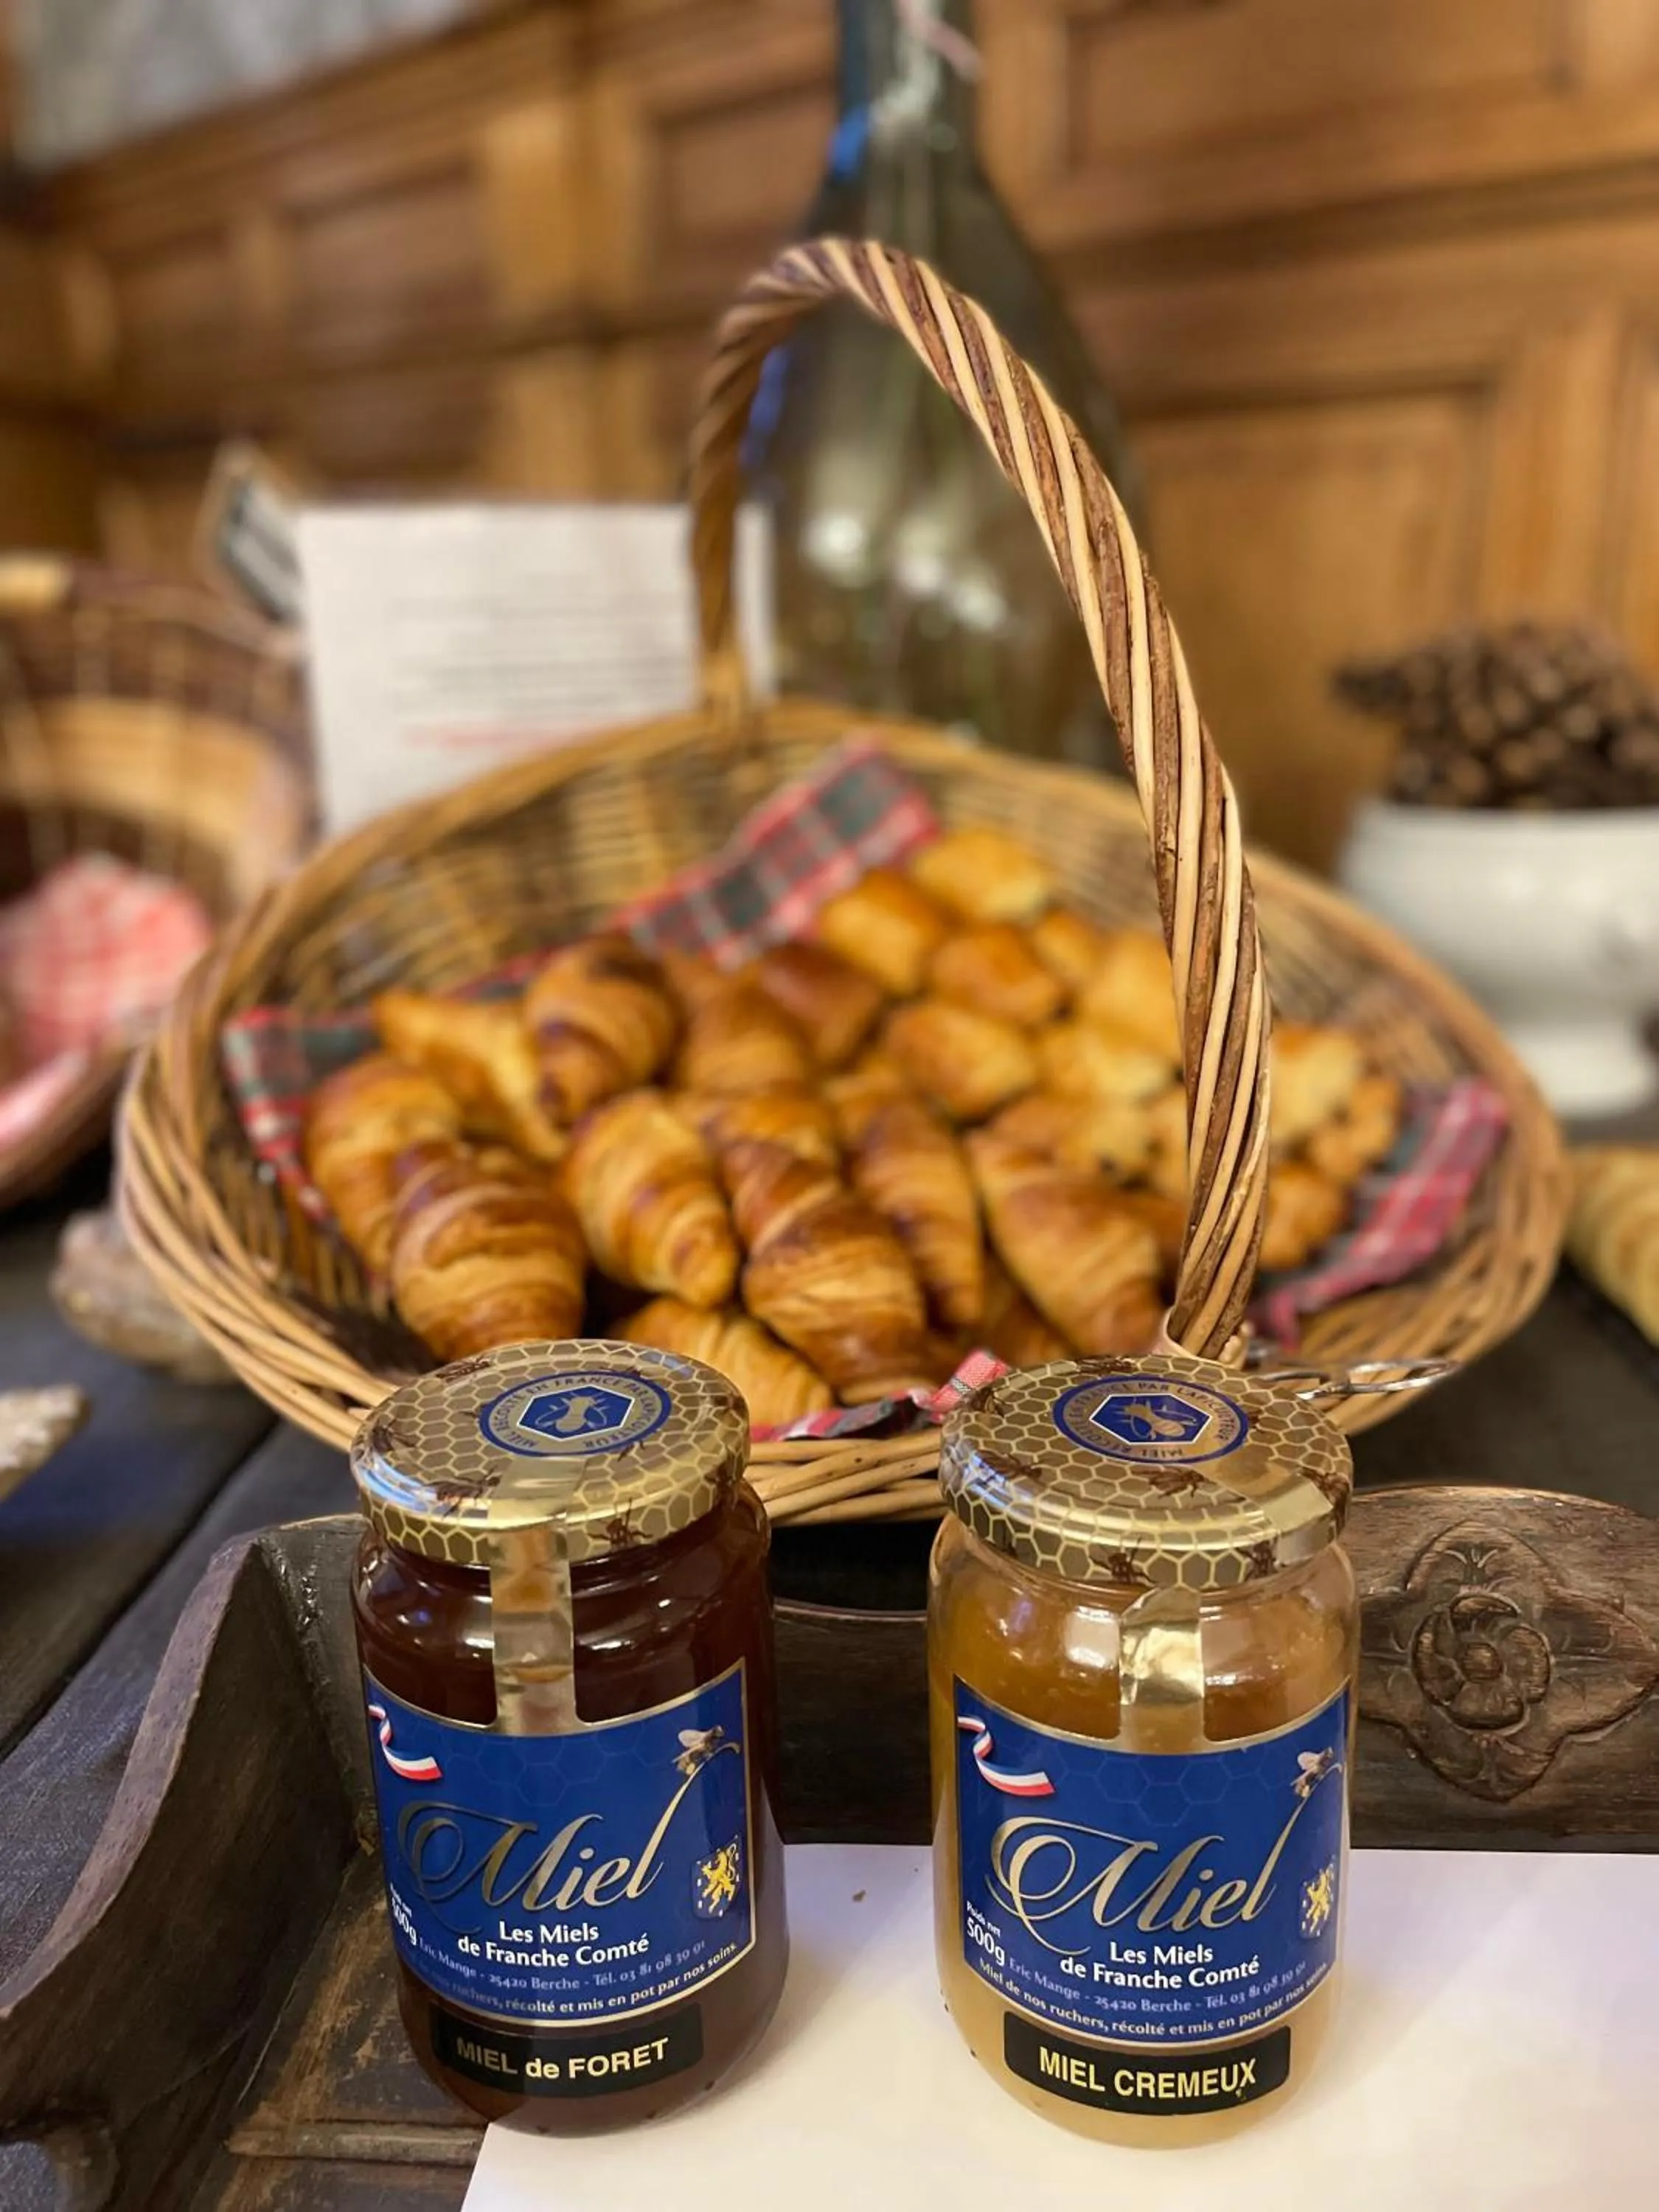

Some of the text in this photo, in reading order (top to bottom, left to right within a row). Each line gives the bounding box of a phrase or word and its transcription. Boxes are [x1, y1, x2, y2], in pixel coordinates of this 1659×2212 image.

[554, 1376, 622, 1386] FRANCE
[1137, 1382, 1169, 1391] PAR
[398, 1742, 740, 1933] Miel
[984, 1763, 1342, 1955] Miel
[457, 1932, 650, 1967] de Franche Comté
[499, 1921, 599, 1944] Les Miels
[966, 1916, 1006, 1967] 500g
[439, 1950, 477, 1979] Mange
[531, 1976, 580, 1990] Berche
[1060, 1955, 1260, 1989] de Franche Comté
[1110, 1941, 1214, 1966] Les Miels
[505, 1998, 556, 2013] récolté
[560, 2003, 574, 2013] et
[577, 1997, 604, 2012] mis
[608, 1995, 626, 2007] en
[630, 1985, 655, 2005] pot
[658, 1976, 680, 1995] par
[684, 1964, 706, 1982] nos
[979, 1957, 1004, 1986] Miel
[1005, 1980, 1020, 1995] de
[1023, 1991, 1046, 2010] nos
[1049, 2004, 1109, 2033] ruchers,
[1112, 2020, 1165, 2036] récolté
[1169, 2024, 1185, 2035] et
[1187, 2020, 1214, 2035] mis
[1217, 2017, 1236, 2029] en
[1239, 2008, 1262, 2027] pot
[1264, 1997, 1284, 2017] par
[1034, 1971, 1081, 2000] Mange
[1094, 1995, 1137, 2011] 25420
[1141, 1999, 1192, 2012] Berche
[456, 2037, 669, 2079] MIEL de FORET
[1038, 2046, 1256, 2099] MIEL CREMEUX
